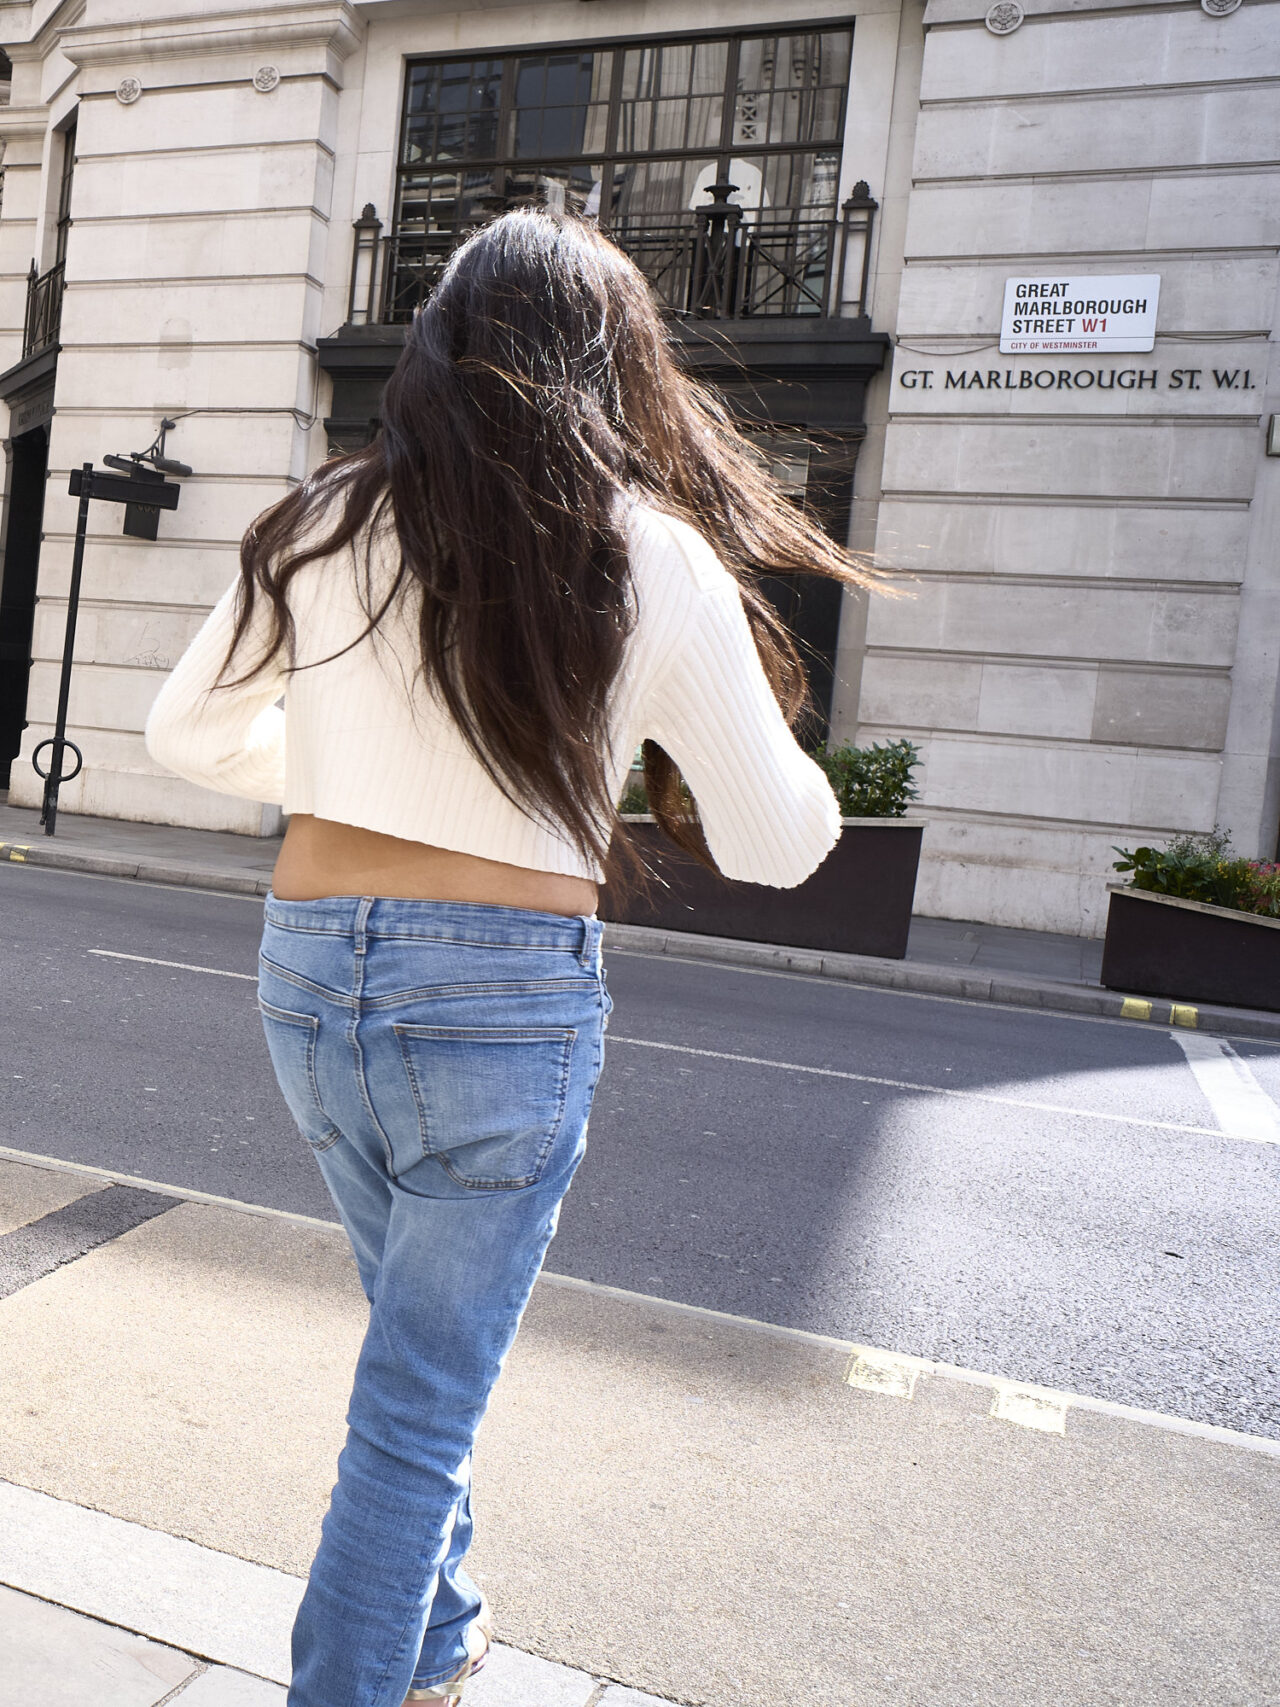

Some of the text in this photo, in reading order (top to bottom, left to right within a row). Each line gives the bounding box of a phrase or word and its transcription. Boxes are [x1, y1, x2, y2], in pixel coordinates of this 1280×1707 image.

[1016, 283, 1069, 298] GREAT
[1014, 299, 1147, 315] MARLBOROUGH
[1012, 318, 1107, 334] STREET W1
[1010, 341, 1098, 350] CITY OF WESTMINSTER
[899, 370, 933, 389] GT.
[945, 369, 1158, 389] MARLBOROUGH
[1169, 369, 1201, 390] ST.
